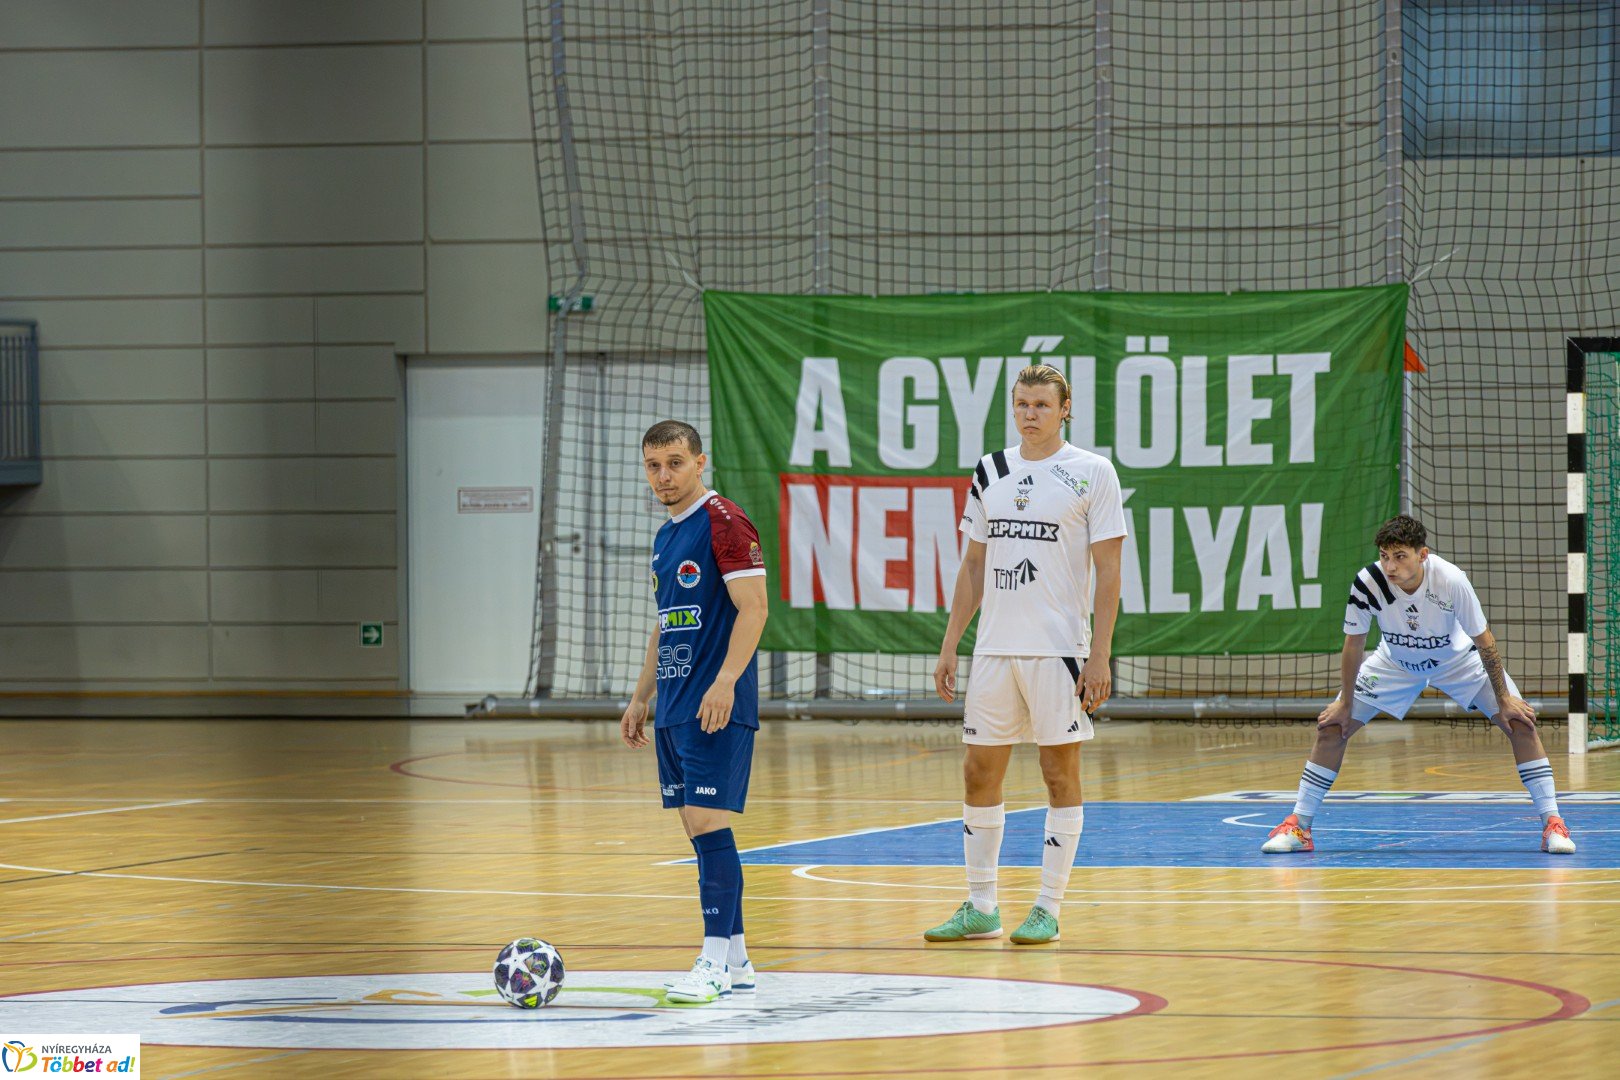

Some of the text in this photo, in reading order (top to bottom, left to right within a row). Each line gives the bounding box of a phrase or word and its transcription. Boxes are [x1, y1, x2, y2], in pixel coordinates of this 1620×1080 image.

[788, 356, 852, 468] A
[787, 482, 1324, 614] NEM ÁLYA!
[993, 568, 1019, 591] TENT
[657, 643, 692, 667] 90
[695, 786, 717, 796] JAKO
